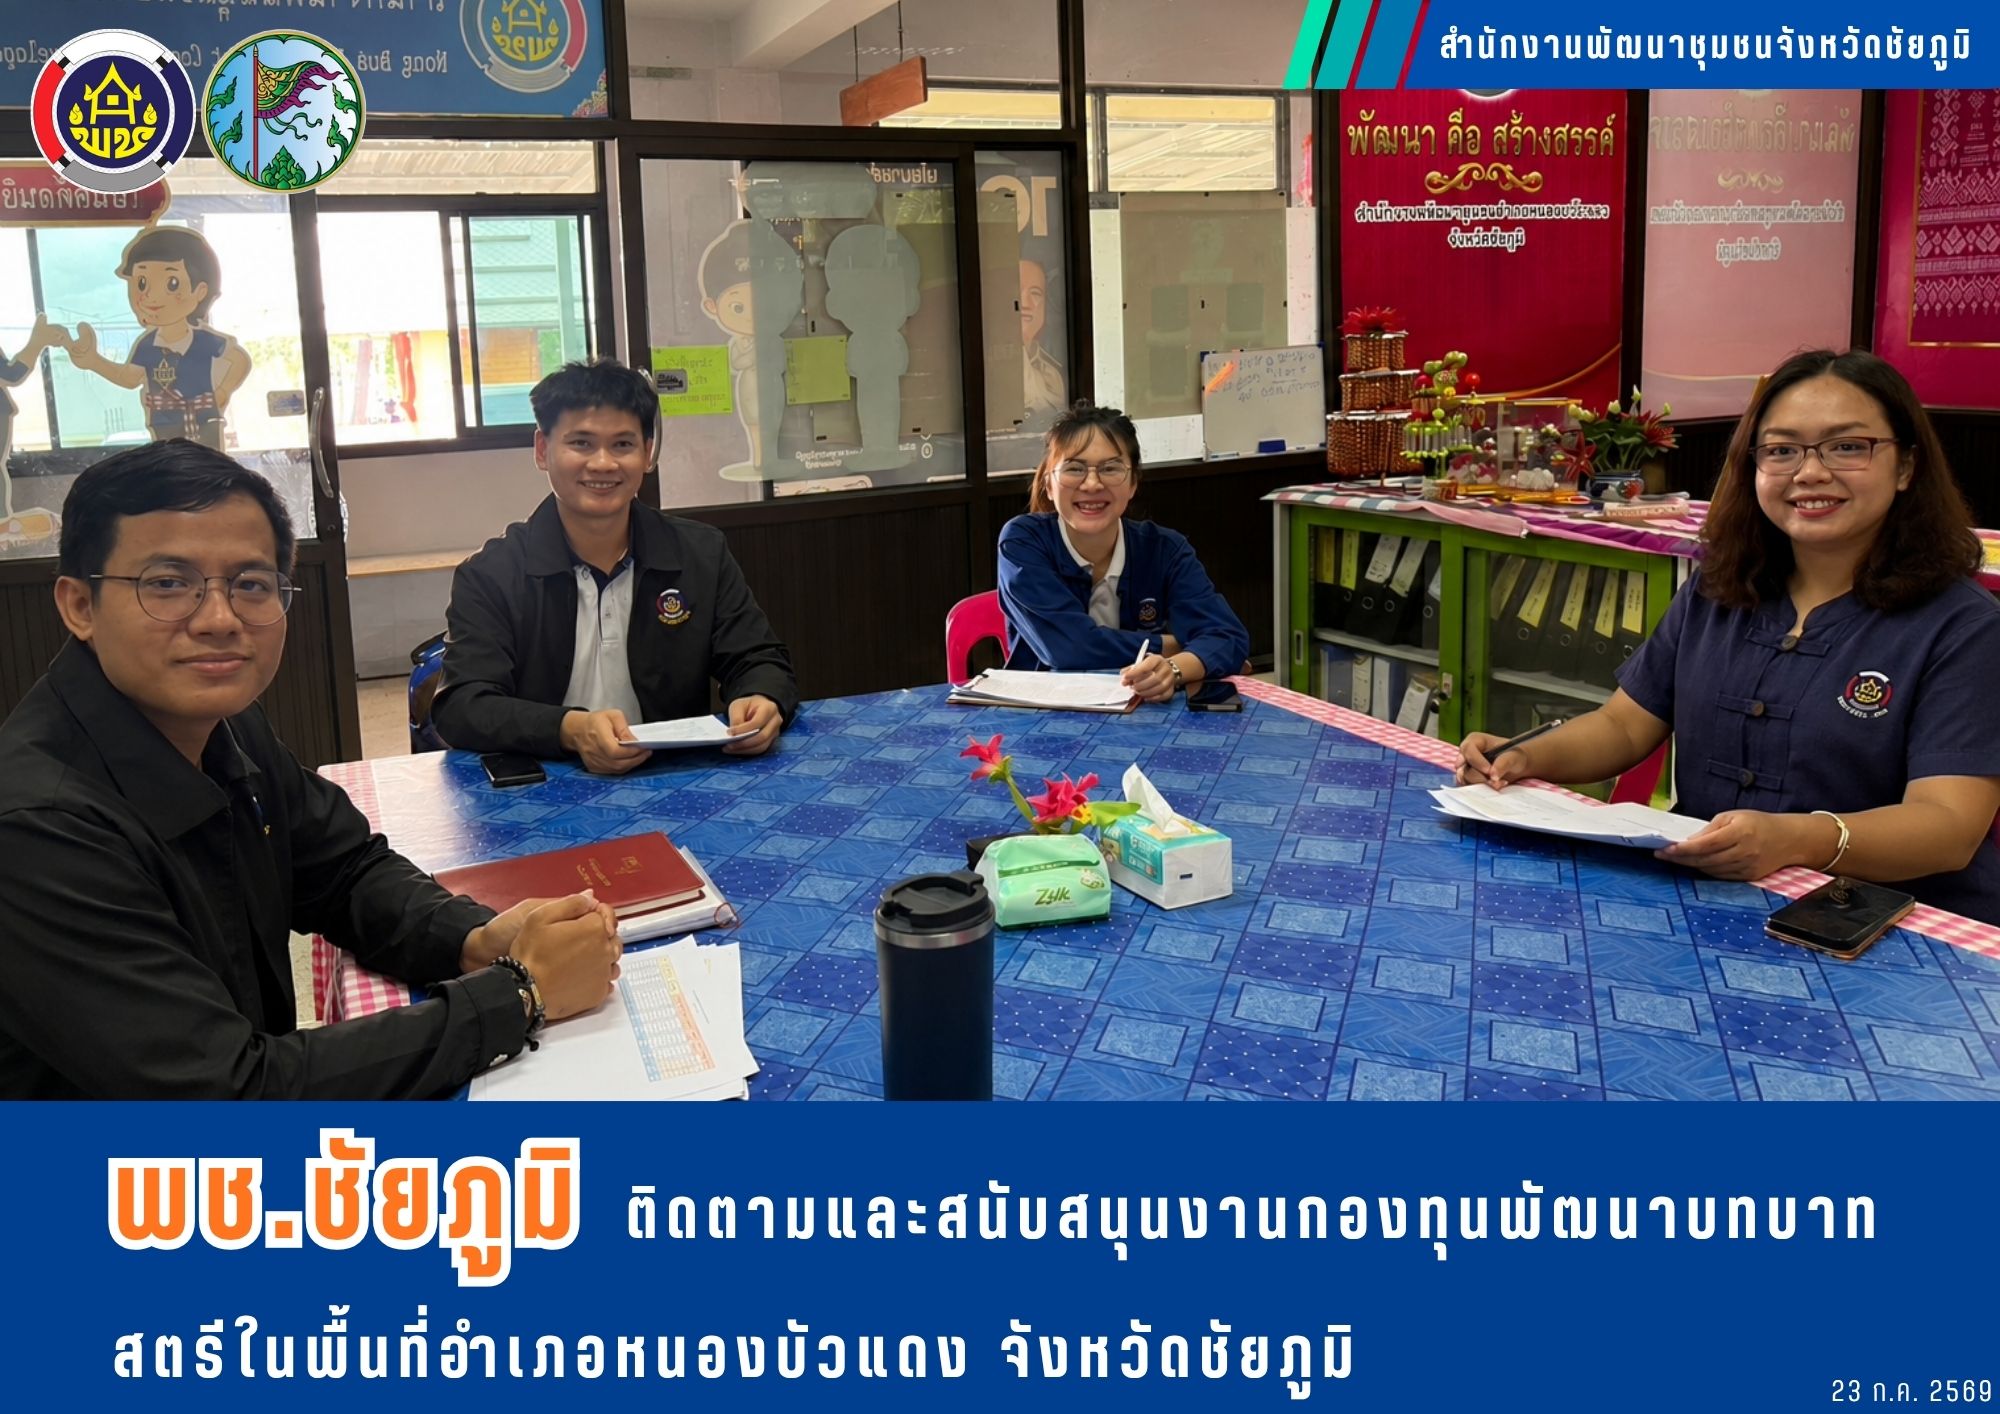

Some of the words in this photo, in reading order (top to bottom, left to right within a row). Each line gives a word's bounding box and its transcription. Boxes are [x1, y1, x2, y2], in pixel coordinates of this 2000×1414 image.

[1347, 108, 1437, 157] พัฒนา
[1447, 106, 1482, 156] คือ
[1492, 108, 1617, 158] สร้างสรรค์
